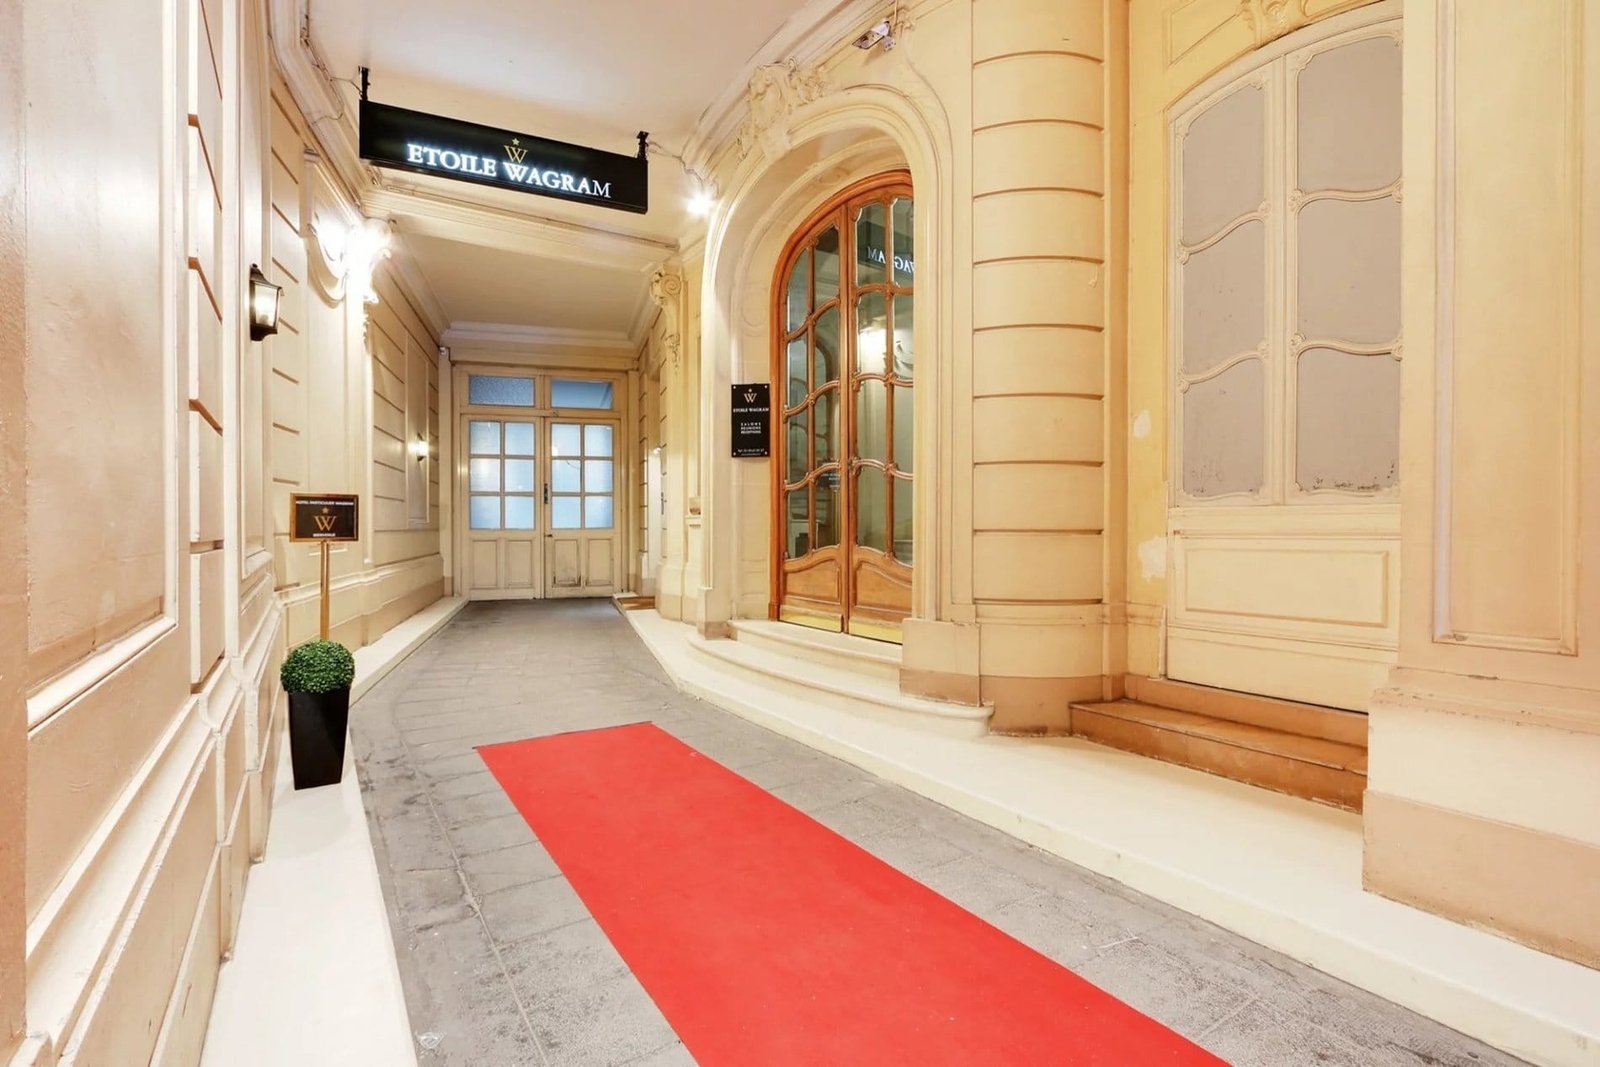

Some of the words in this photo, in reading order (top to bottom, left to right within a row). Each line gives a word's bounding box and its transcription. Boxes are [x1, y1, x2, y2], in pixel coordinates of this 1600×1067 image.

[504, 145, 528, 164] W
[407, 143, 497, 177] ETOILE
[503, 161, 611, 198] WAGRAM
[744, 393, 757, 403] W
[314, 515, 337, 531] W
